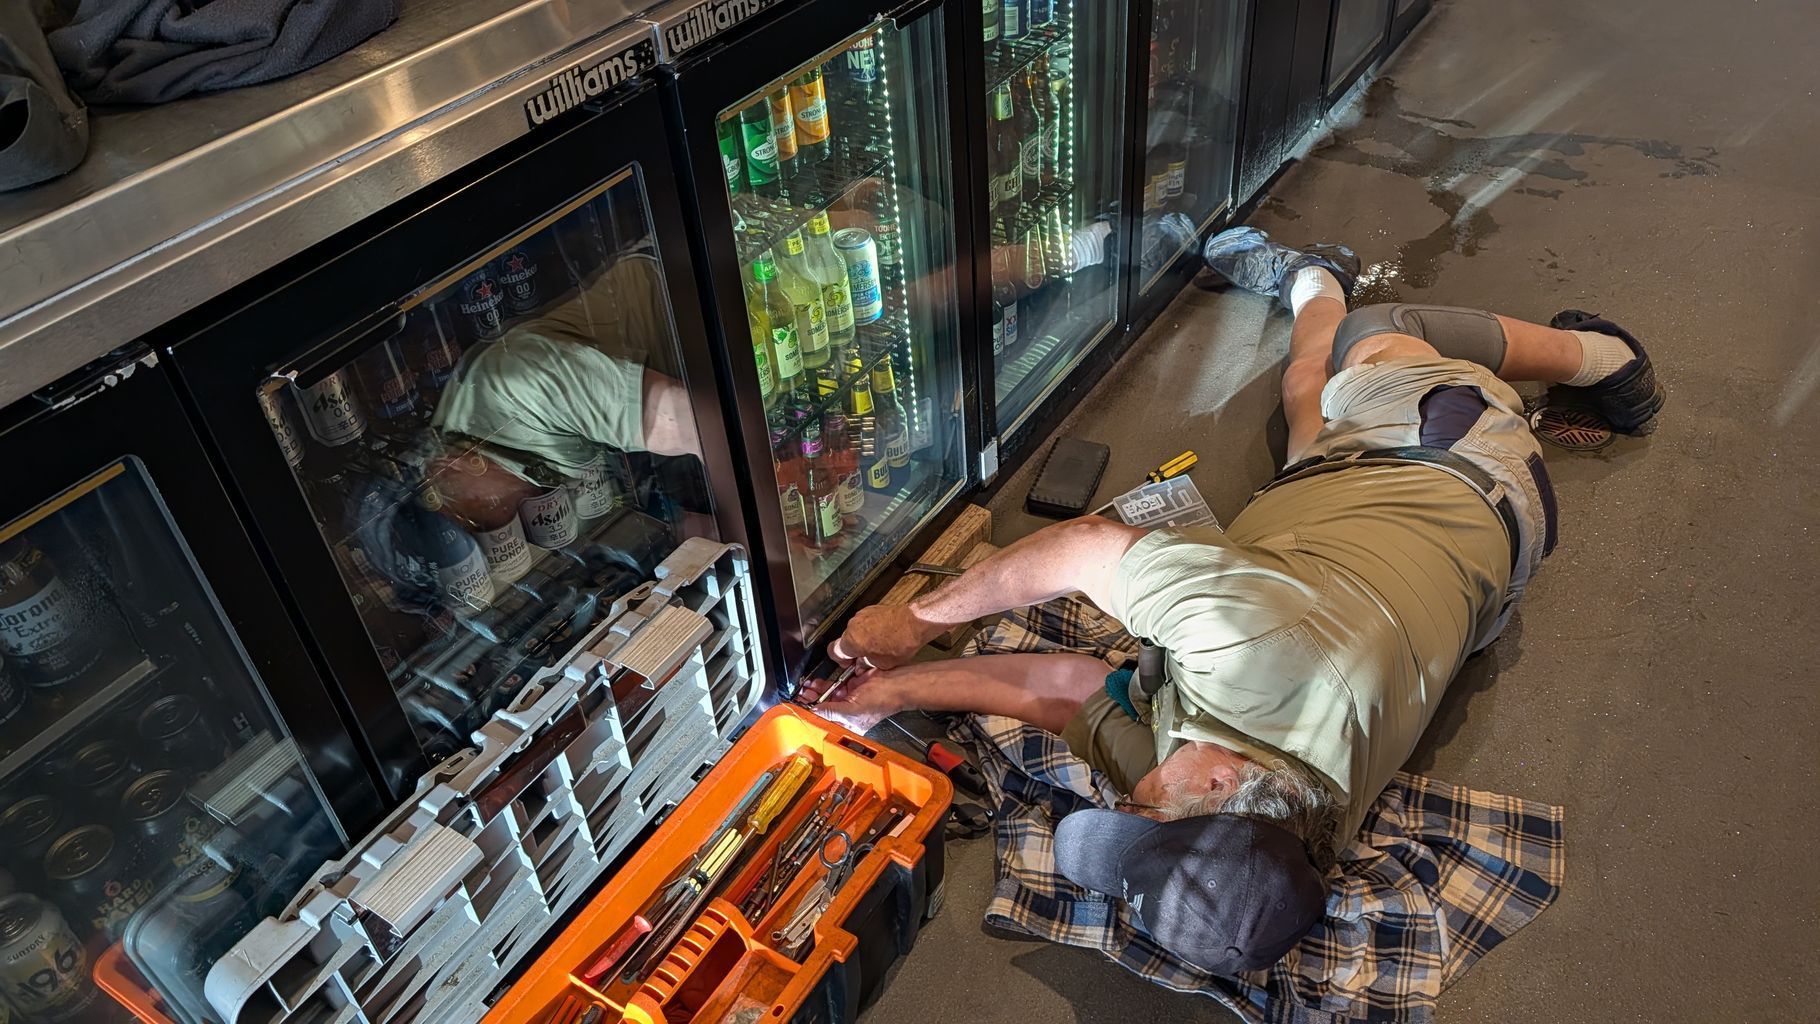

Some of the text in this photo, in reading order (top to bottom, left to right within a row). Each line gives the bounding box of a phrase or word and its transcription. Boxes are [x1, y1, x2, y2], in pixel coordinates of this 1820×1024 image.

[527, 49, 638, 125] williams
[531, 502, 570, 527] Asahi
[537, 497, 562, 512] DRY
[550, 523, 564, 534] 3.5
[487, 541, 526, 565] BLONDE
[491, 537, 520, 555] PURE
[455, 568, 482, 588] PURE
